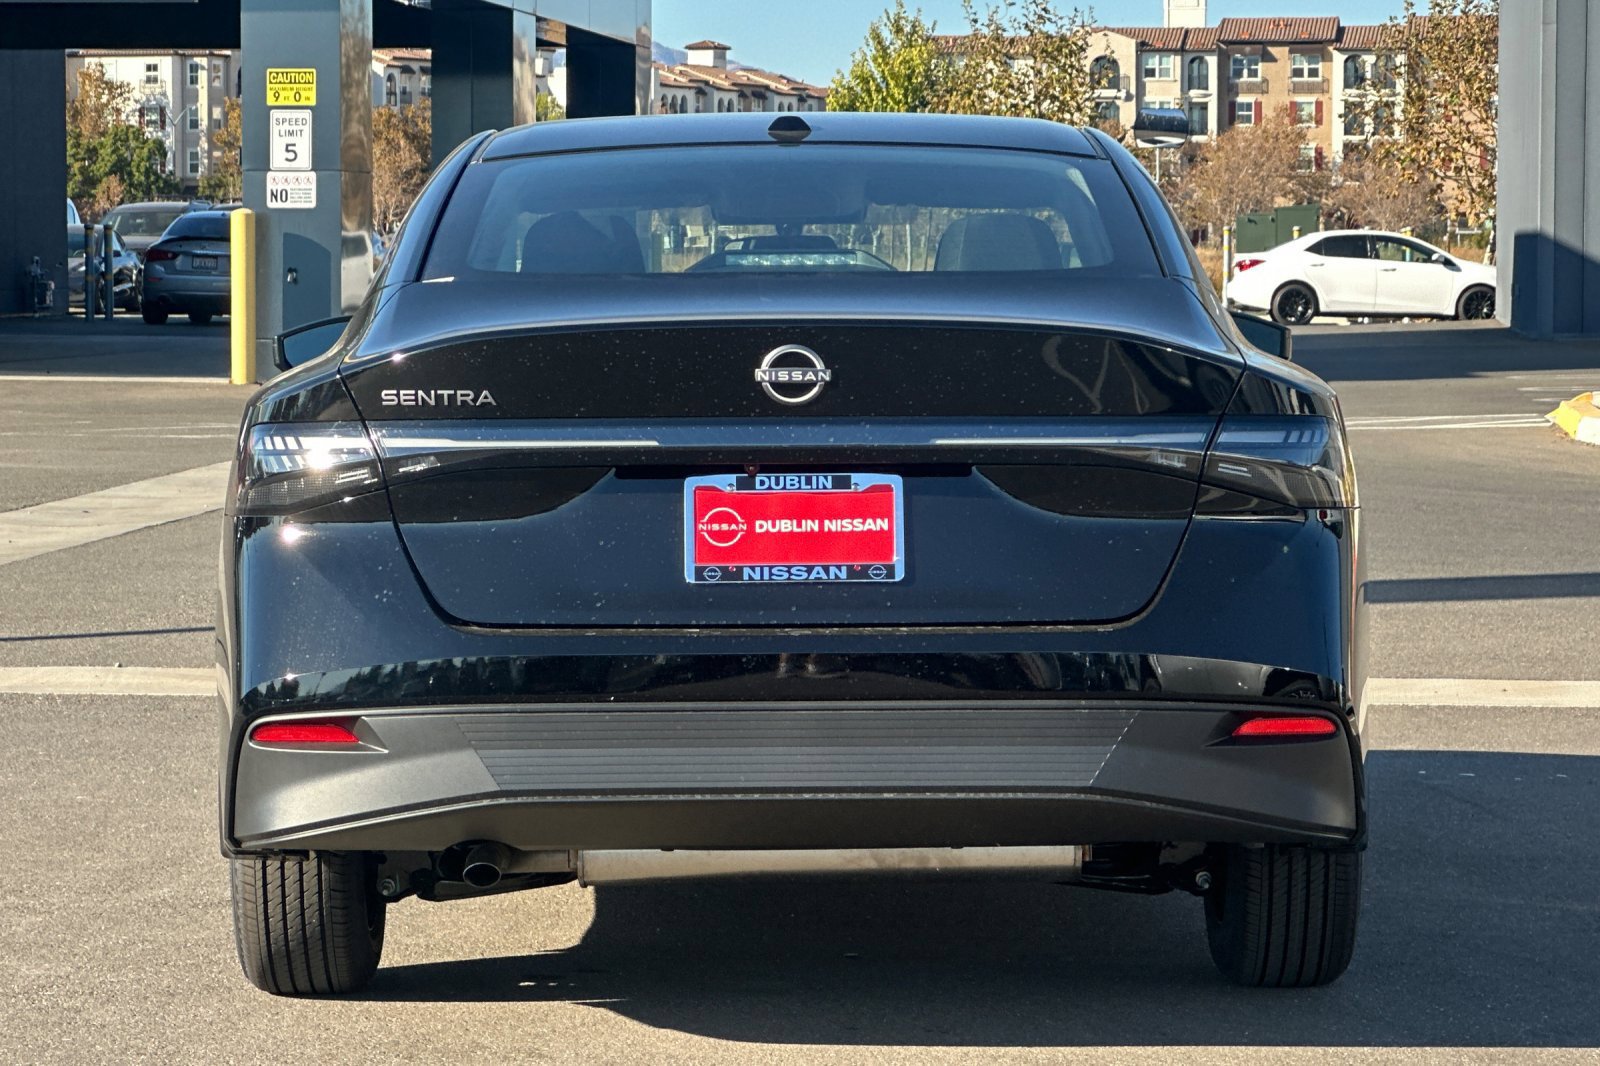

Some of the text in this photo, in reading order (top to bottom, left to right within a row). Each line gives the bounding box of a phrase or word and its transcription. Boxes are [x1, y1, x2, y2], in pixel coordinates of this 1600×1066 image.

[270, 72, 313, 83] CAUTION
[273, 91, 280, 102] 9
[294, 91, 301, 102] 0
[275, 117, 308, 126] SPEED
[278, 129, 304, 138] LIMIT
[284, 143, 298, 162] 5
[270, 188, 288, 203] NO
[757, 370, 830, 381] NISSAN
[381, 389, 497, 406] SENTRA
[755, 475, 833, 490] DUBLIN
[698, 523, 747, 531] NISSAN
[755, 518, 889, 533] DUBLIN NISSAN
[742, 566, 847, 580] NISSAN
